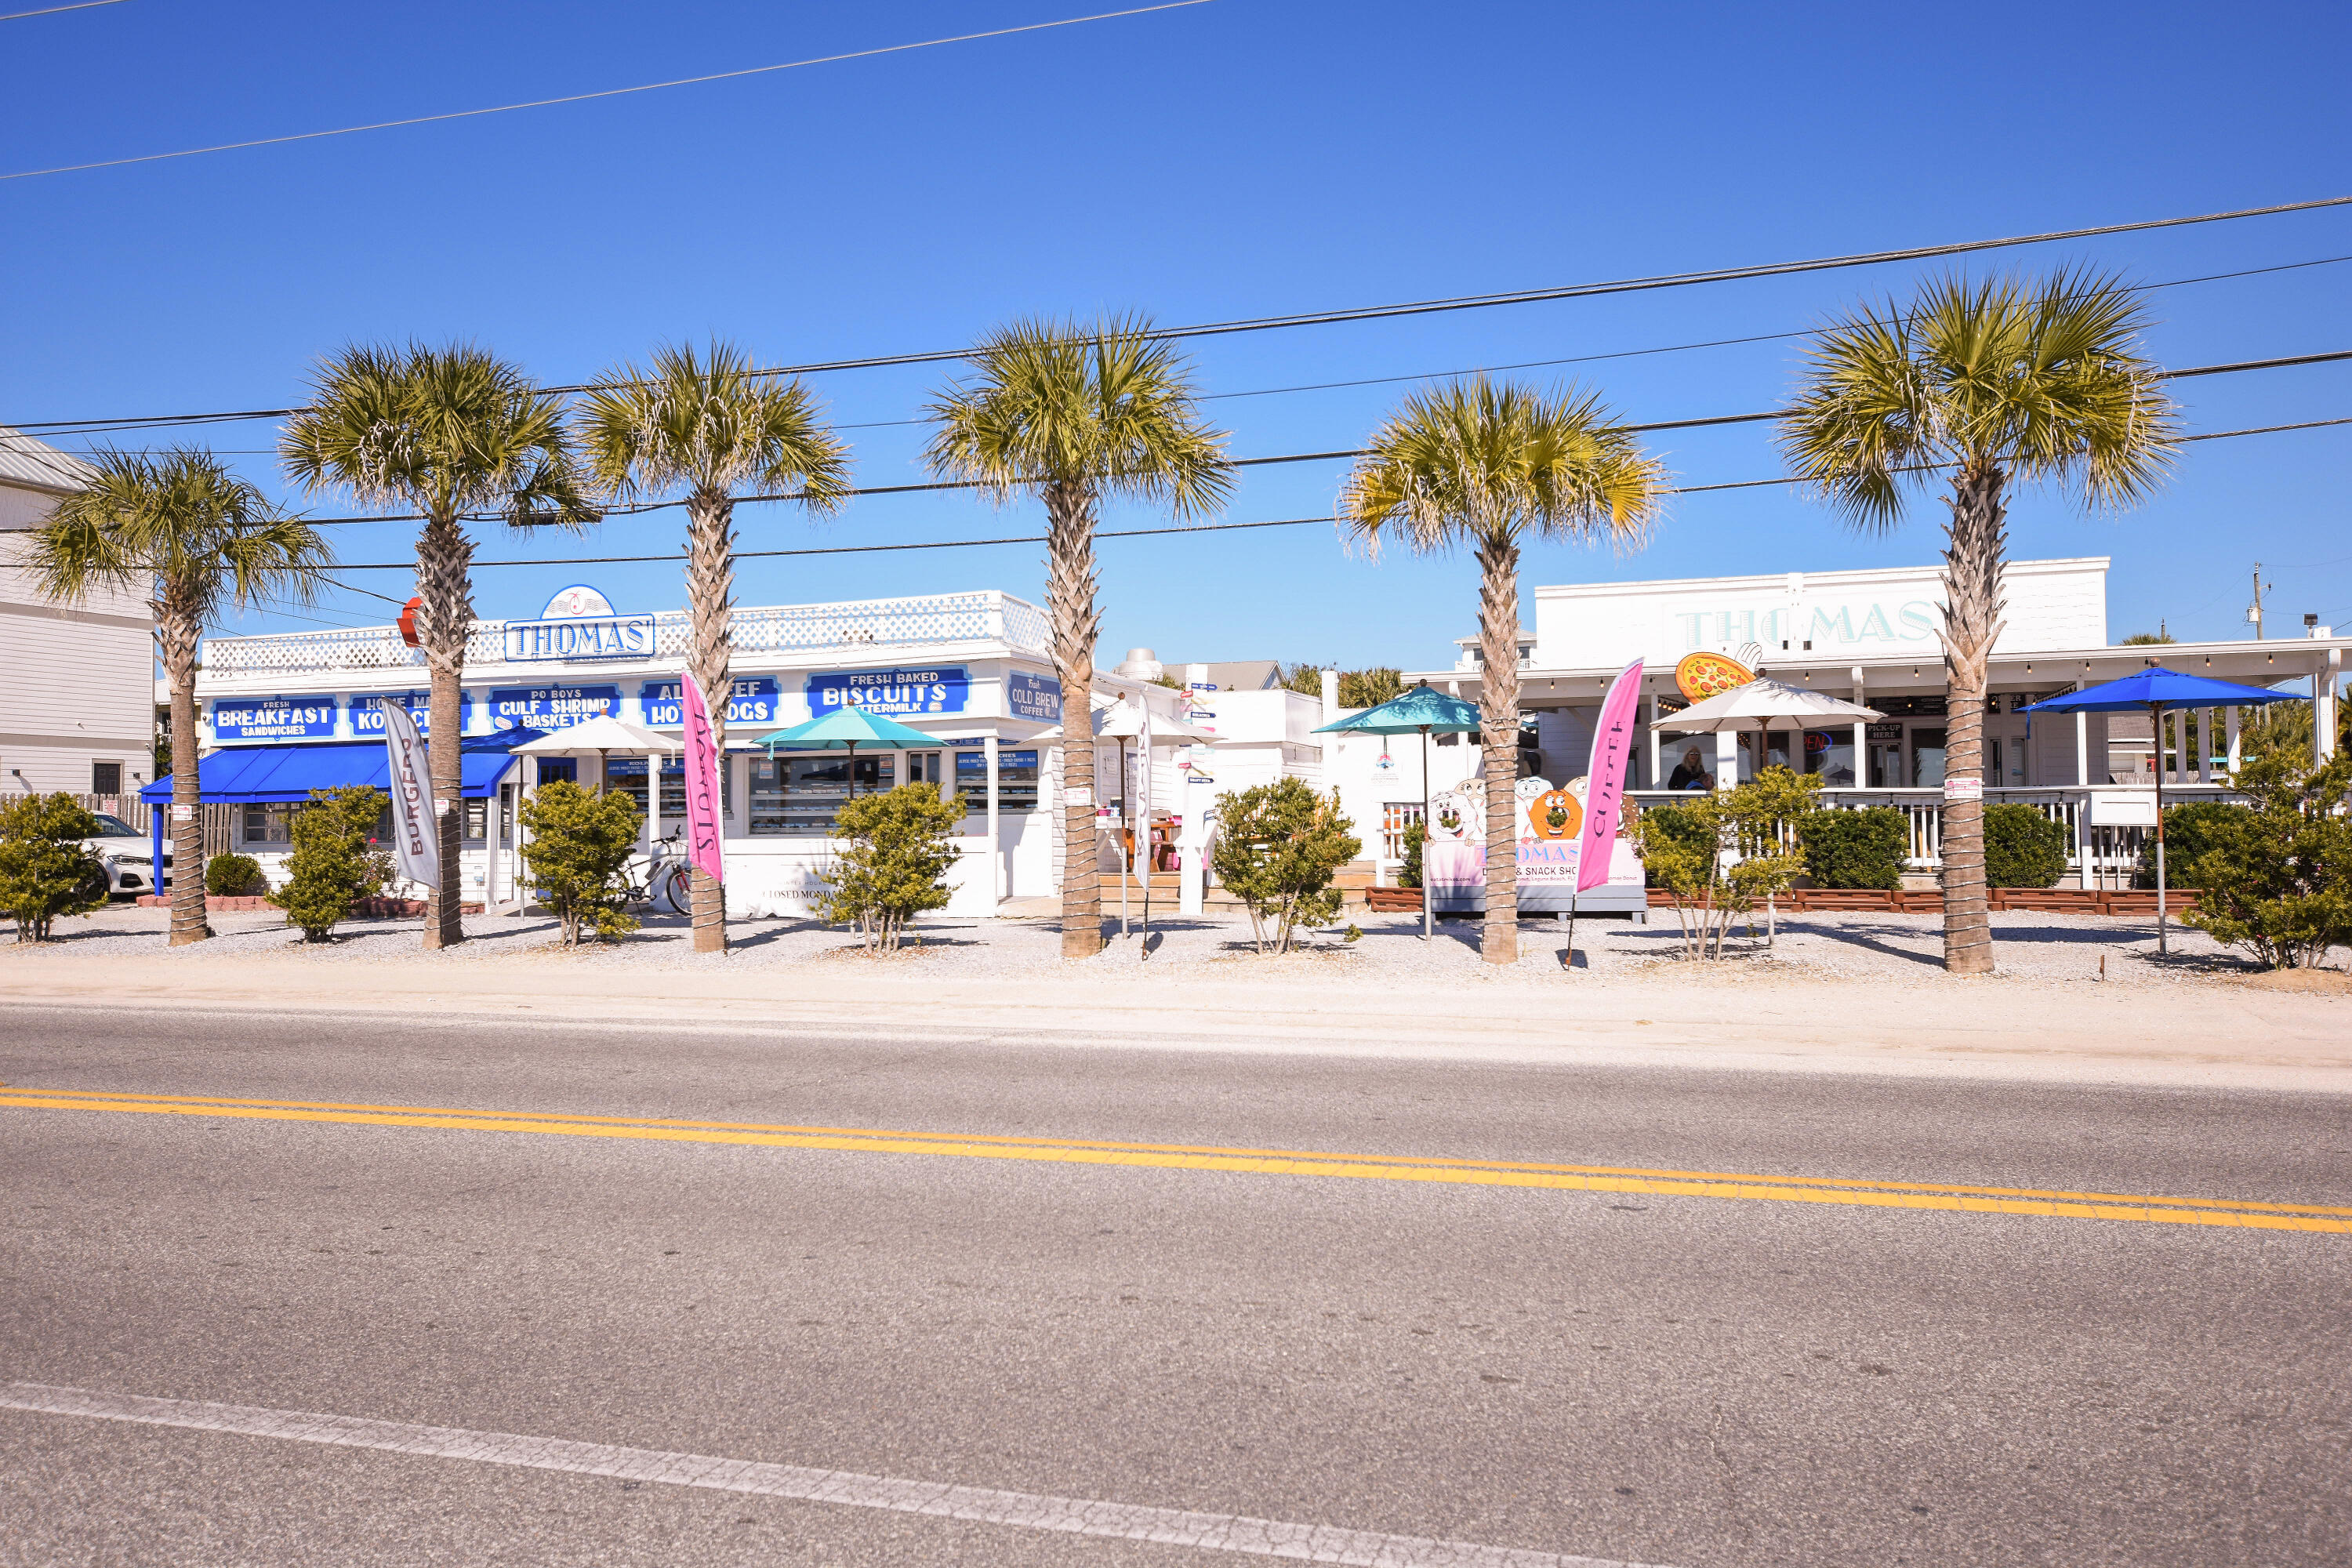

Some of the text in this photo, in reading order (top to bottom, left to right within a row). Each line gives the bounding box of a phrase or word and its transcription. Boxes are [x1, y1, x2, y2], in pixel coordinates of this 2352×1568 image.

[511, 620, 650, 655] THOMAS'
[850, 672, 939, 686] FRESH BAKED
[531, 689, 582, 699] PO BOYS
[823, 684, 947, 706] BISCUITS
[1012, 688, 1059, 709] COLD BREW
[366, 697, 406, 710] HOE
[499, 698, 611, 716] GULF SHRIMP
[1021, 705, 1044, 717] COFFEE
[217, 706, 331, 727] BREAKFAST
[652, 701, 768, 724] HO OGS
[241, 725, 306, 737] SANDWICHES
[1515, 867, 1523, 876] &
[1525, 866, 1557, 876] SNACK
